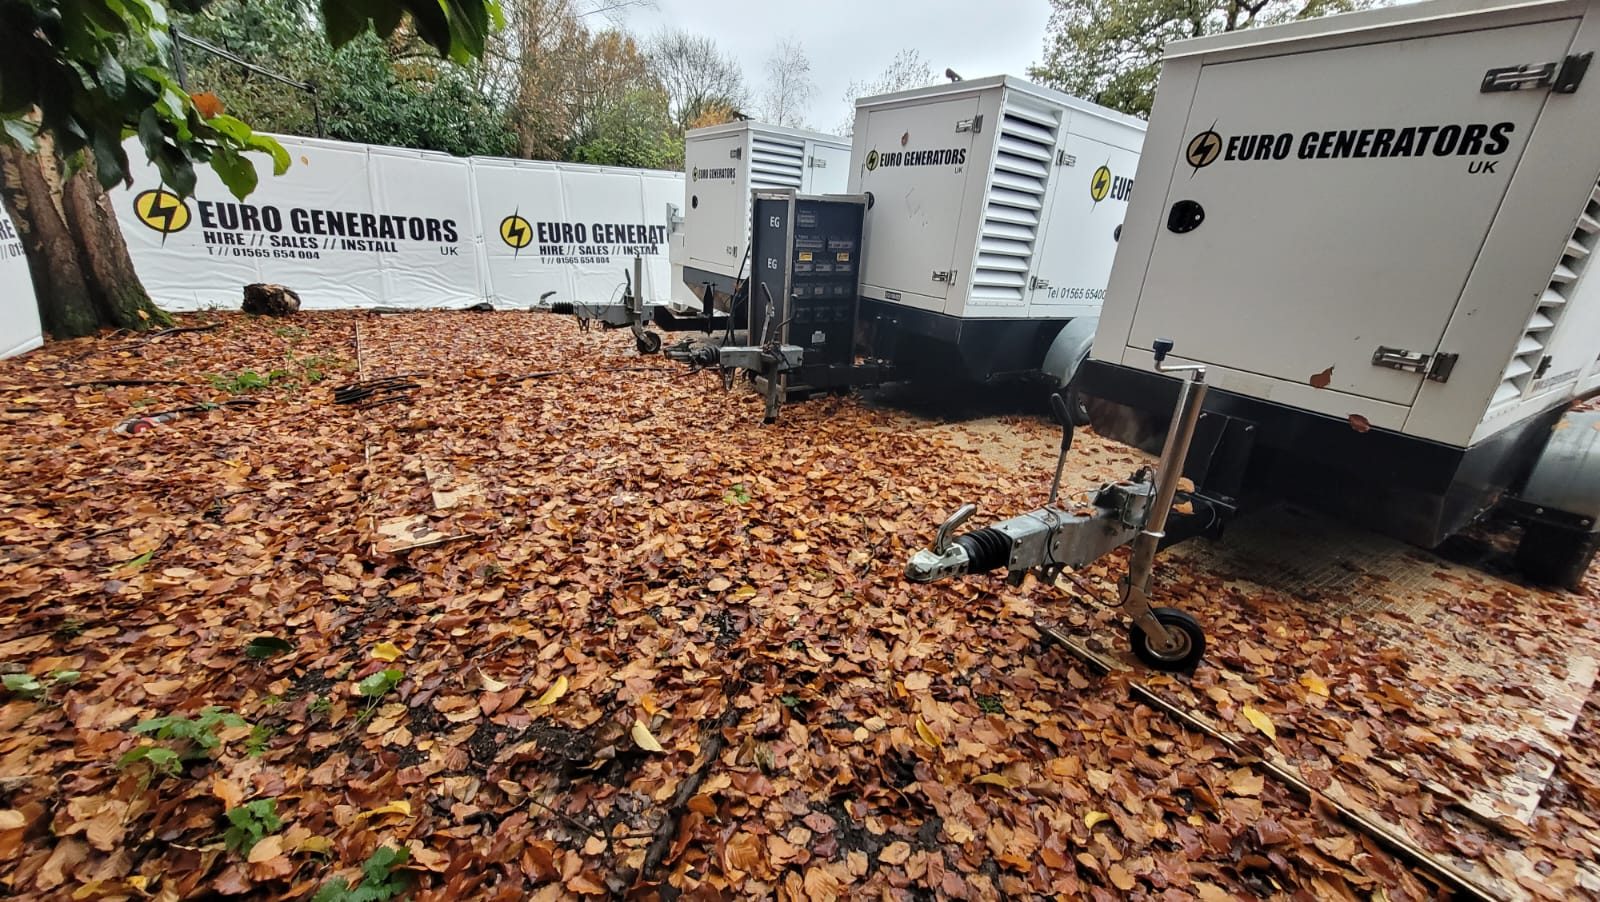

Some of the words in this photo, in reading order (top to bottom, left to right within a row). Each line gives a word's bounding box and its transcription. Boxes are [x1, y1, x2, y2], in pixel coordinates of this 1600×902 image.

[1224, 133, 1293, 161] EURO
[1298, 122, 1515, 159] GENERATORS
[880, 152, 902, 167] EURO
[904, 148, 966, 166] GENERATORS
[1468, 160, 1499, 174] UK
[198, 200, 283, 233] EURO
[290, 207, 458, 243] GENERATORS
[769, 215, 780, 228] EG
[537, 222, 587, 244] EURO
[591, 223, 669, 245] GENERAT
[203, 231, 246, 246] HIRE
[269, 235, 319, 249] SALES
[341, 239, 399, 253] INSTALL
[206, 246, 214, 256] T
[232, 247, 271, 258] 01565
[273, 249, 296, 259] 654
[298, 250, 320, 260] 004
[440, 246, 459, 256] UK
[539, 245, 565, 256] HIRE
[578, 245, 609, 256] SALES
[540, 256, 546, 265] T
[556, 256, 579, 265] 01565
[580, 256, 595, 265] 654
[767, 257, 778, 270] EG
[1047, 286, 1060, 299] Tel
[1060, 287, 1084, 300] 01565
